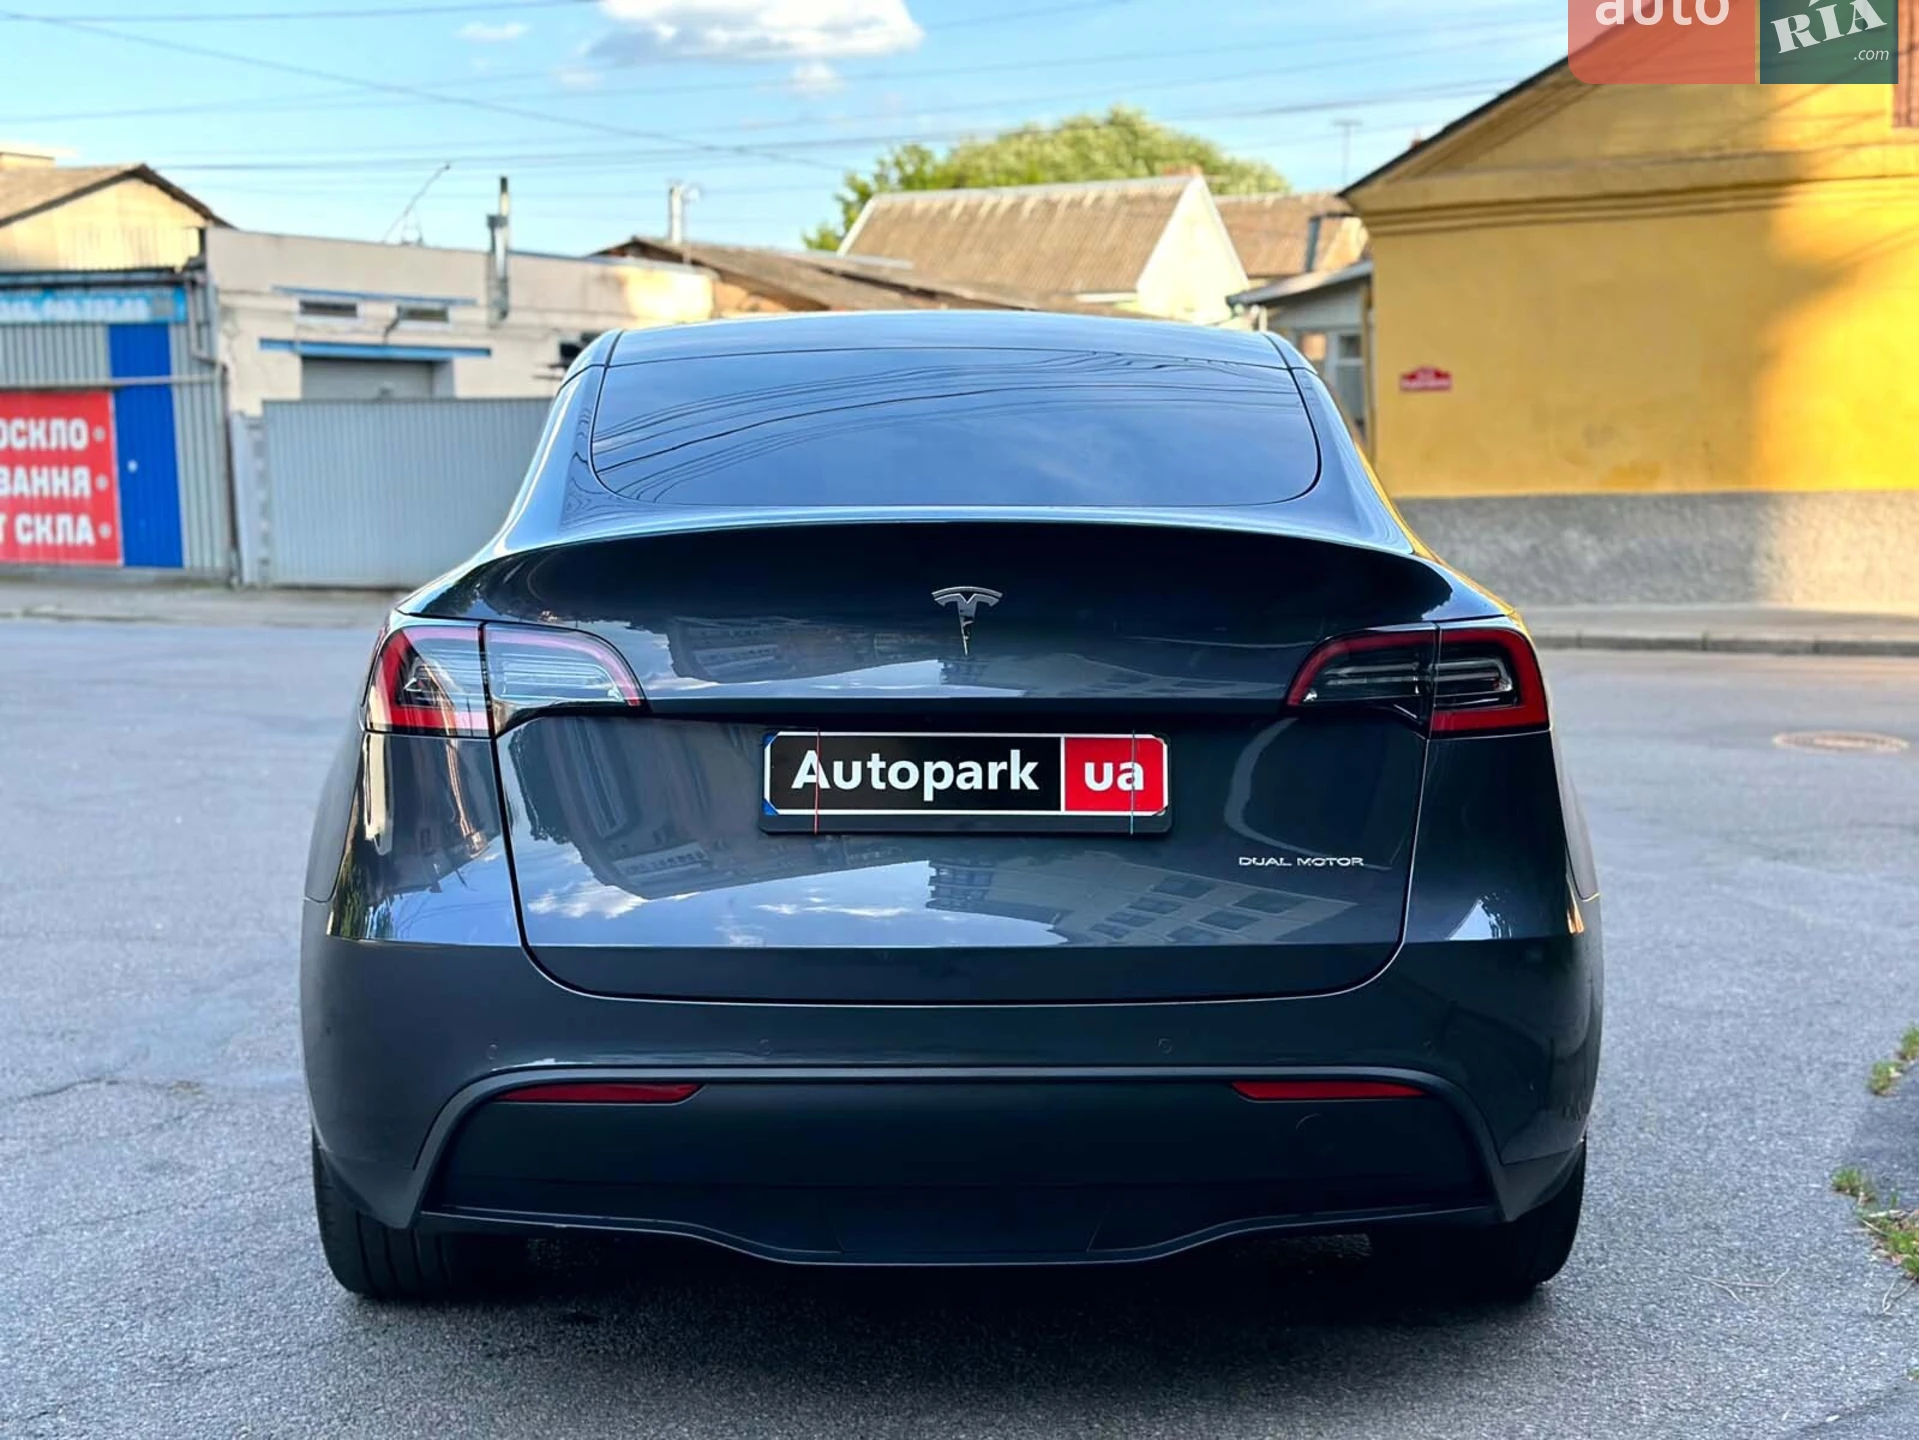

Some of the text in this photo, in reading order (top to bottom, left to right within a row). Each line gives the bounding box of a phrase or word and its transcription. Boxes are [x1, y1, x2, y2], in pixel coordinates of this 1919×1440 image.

[15, 513, 95, 547] СКЛА
[791, 749, 1145, 802] Autopark ua
[1238, 856, 1364, 867] DUAL MOTOR
